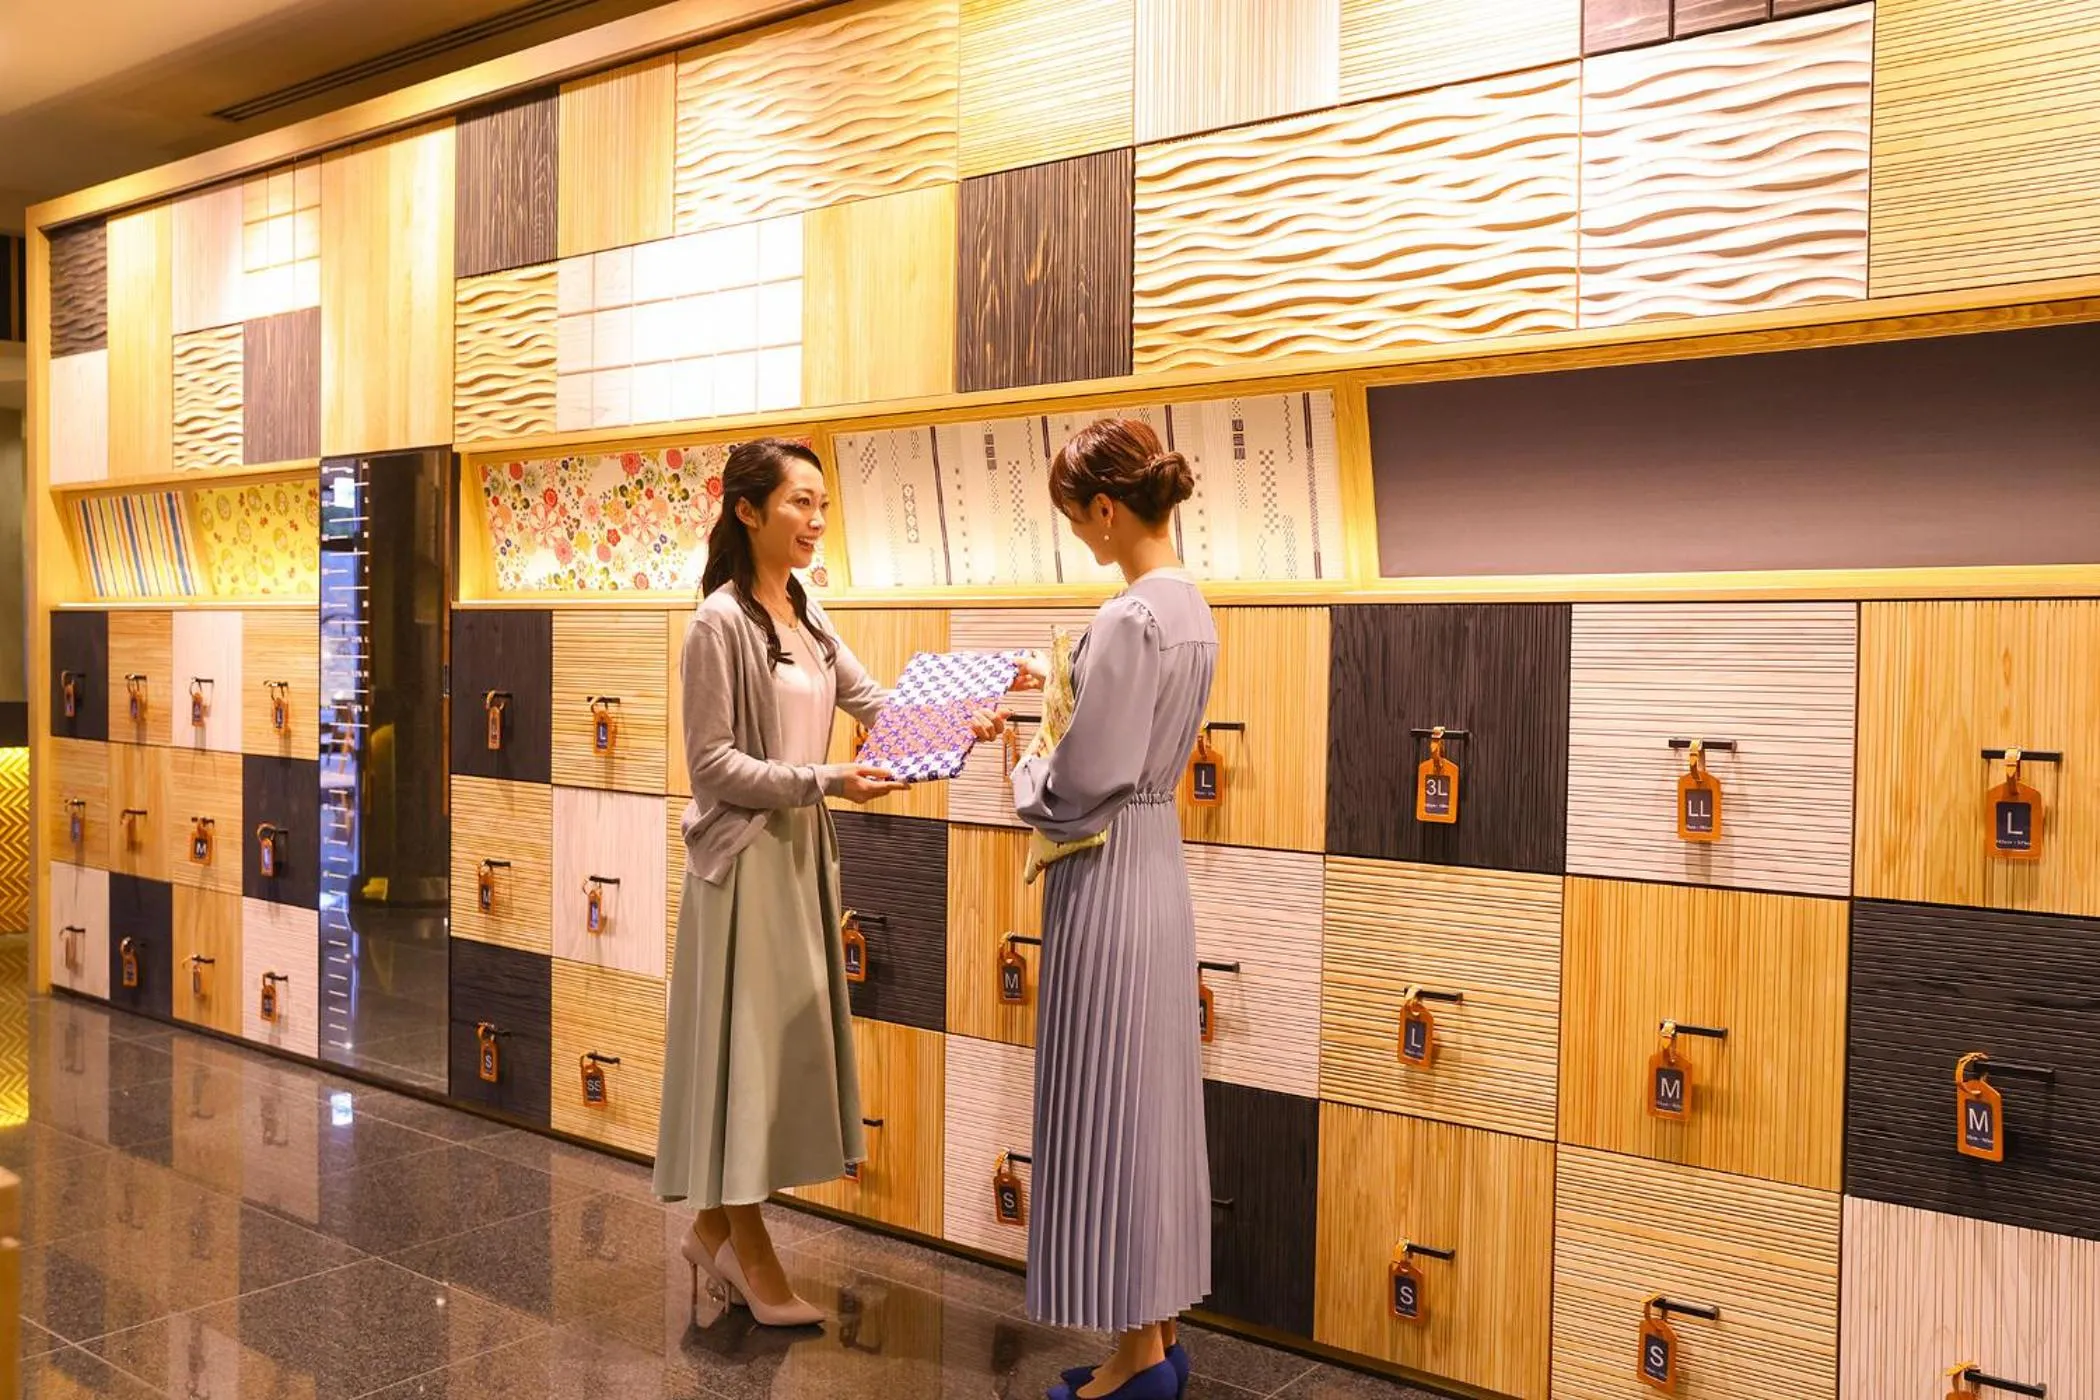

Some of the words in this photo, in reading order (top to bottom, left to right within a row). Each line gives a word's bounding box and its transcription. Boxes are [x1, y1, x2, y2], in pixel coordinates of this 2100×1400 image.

[599, 725, 606, 740] L
[1202, 770, 1212, 788] L
[1426, 780, 1448, 796] 3L
[1688, 800, 1711, 817] LL
[2008, 812, 2023, 835] L
[196, 842, 206, 852] M
[850, 948, 858, 965] L
[1005, 974, 1018, 988] M
[1410, 1028, 1422, 1048] L
[486, 1055, 492, 1068] S
[587, 1080, 601, 1092] SS
[1661, 1078, 1680, 1099] M
[1969, 1108, 1989, 1133] M
[1004, 1192, 1014, 1208] S
[1400, 1286, 1413, 1305] S
[1650, 1346, 1664, 1367] S
